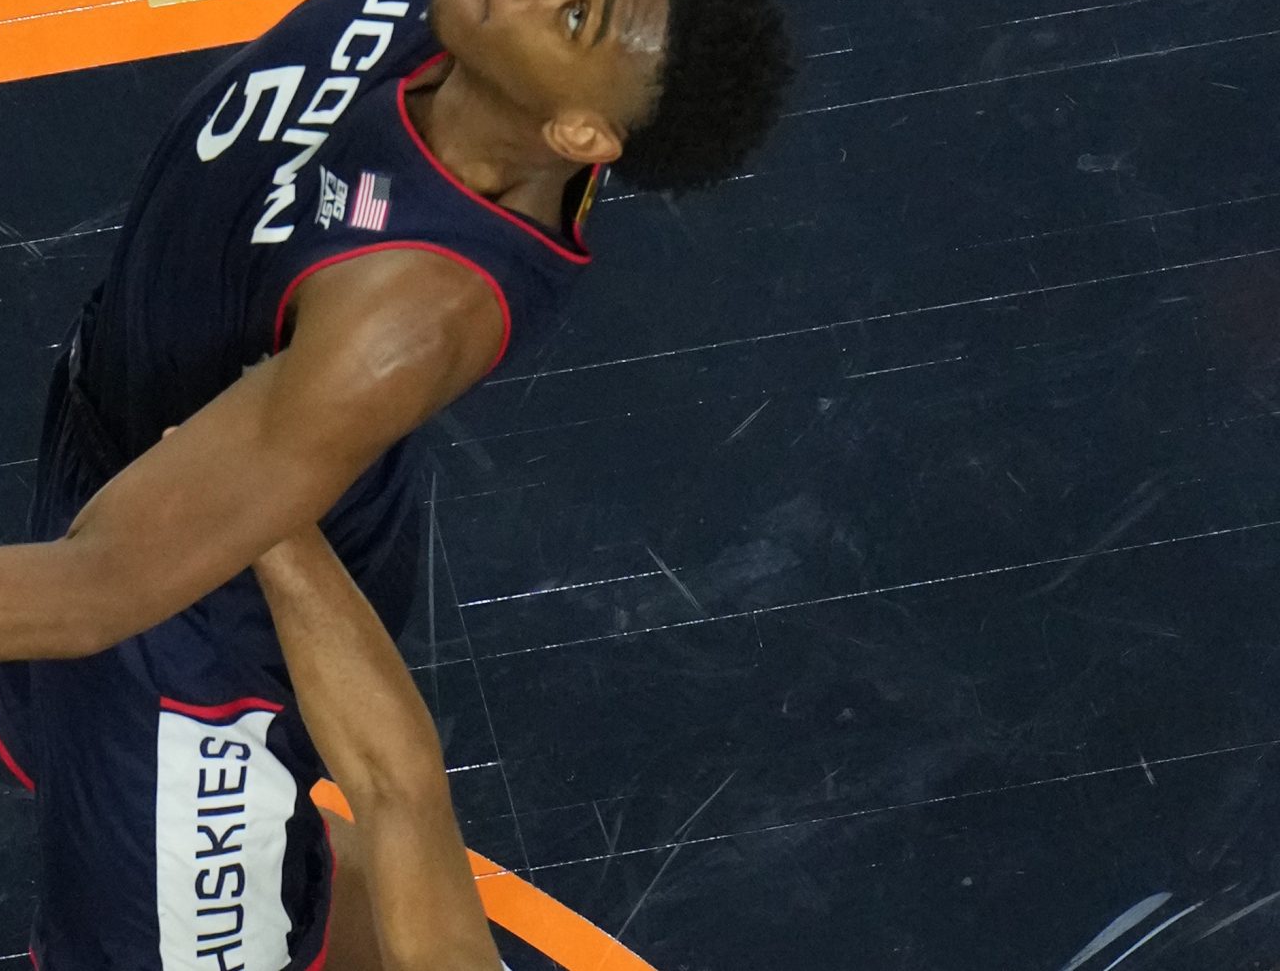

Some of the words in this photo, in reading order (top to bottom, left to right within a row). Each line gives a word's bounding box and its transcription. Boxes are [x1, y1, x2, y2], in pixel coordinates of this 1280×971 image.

[196, 65, 306, 162] 5
[319, 170, 338, 230] EAST
[332, 178, 349, 222] BIG
[195, 736, 252, 971] HUSKIES
